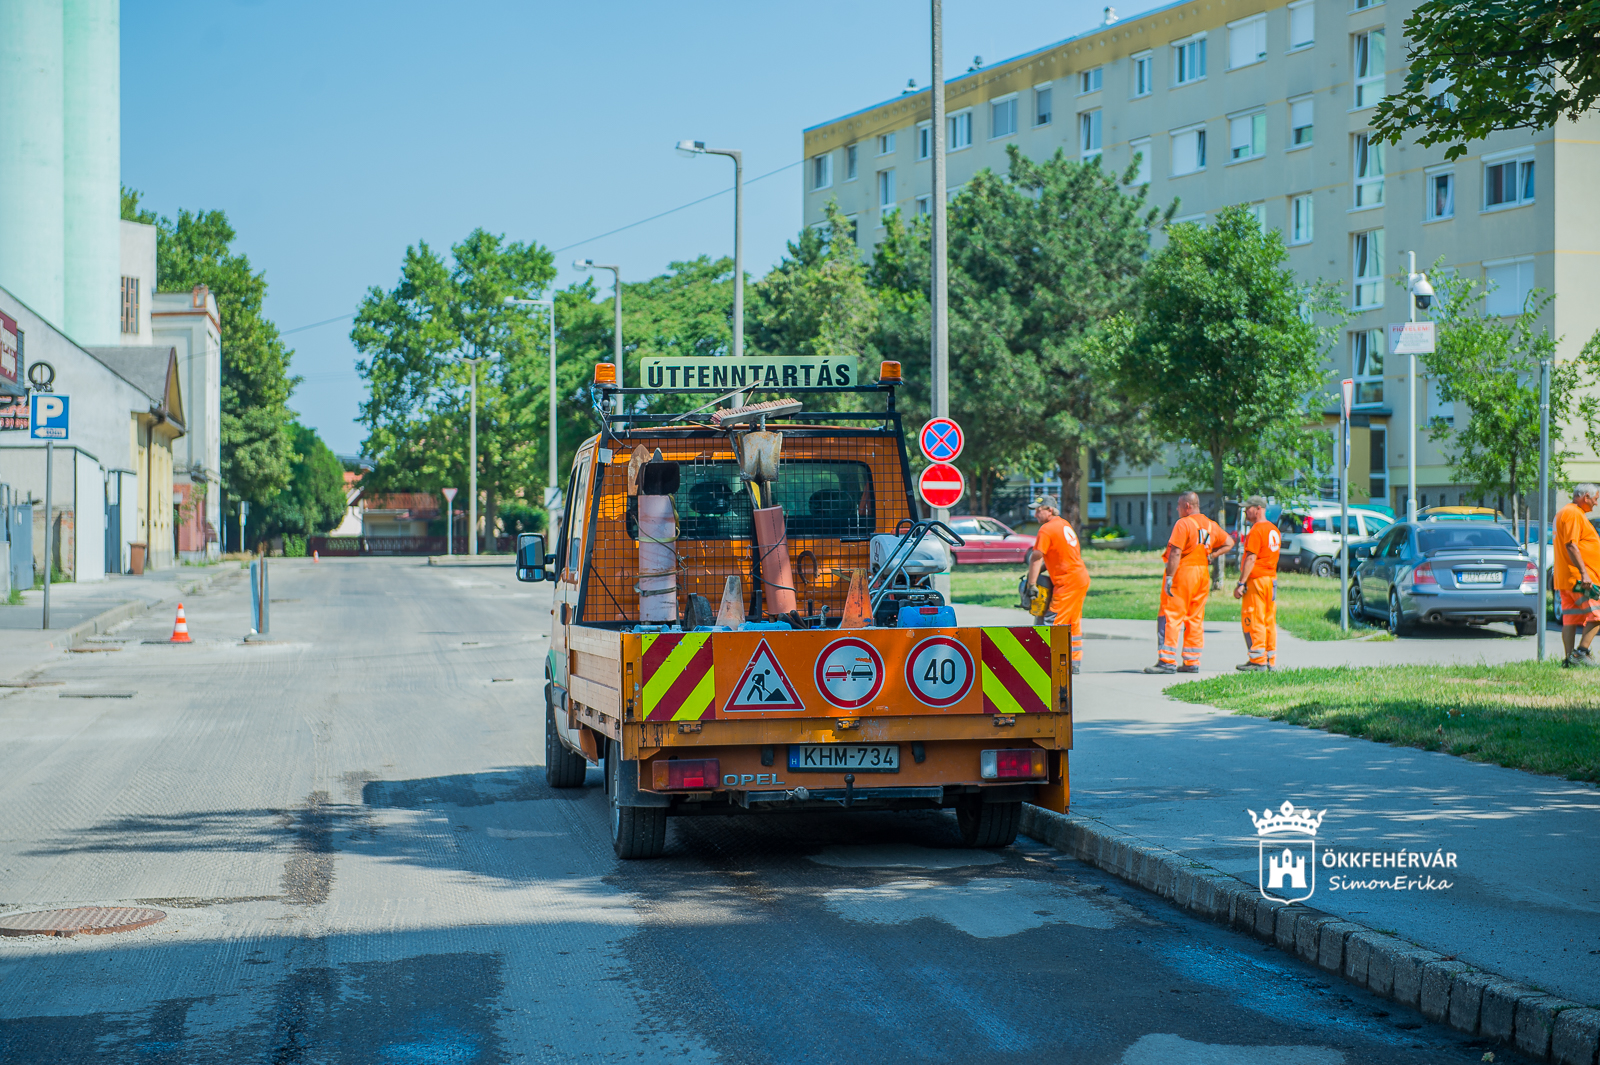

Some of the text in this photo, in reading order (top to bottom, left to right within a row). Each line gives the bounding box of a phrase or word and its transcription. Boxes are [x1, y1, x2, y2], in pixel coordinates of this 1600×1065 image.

[648, 359, 851, 388] ÚTFENNTARTÁS
[36, 396, 64, 426] P
[923, 658, 956, 685] 40
[804, 747, 894, 766] KHM-734
[723, 773, 786, 786] OPEL
